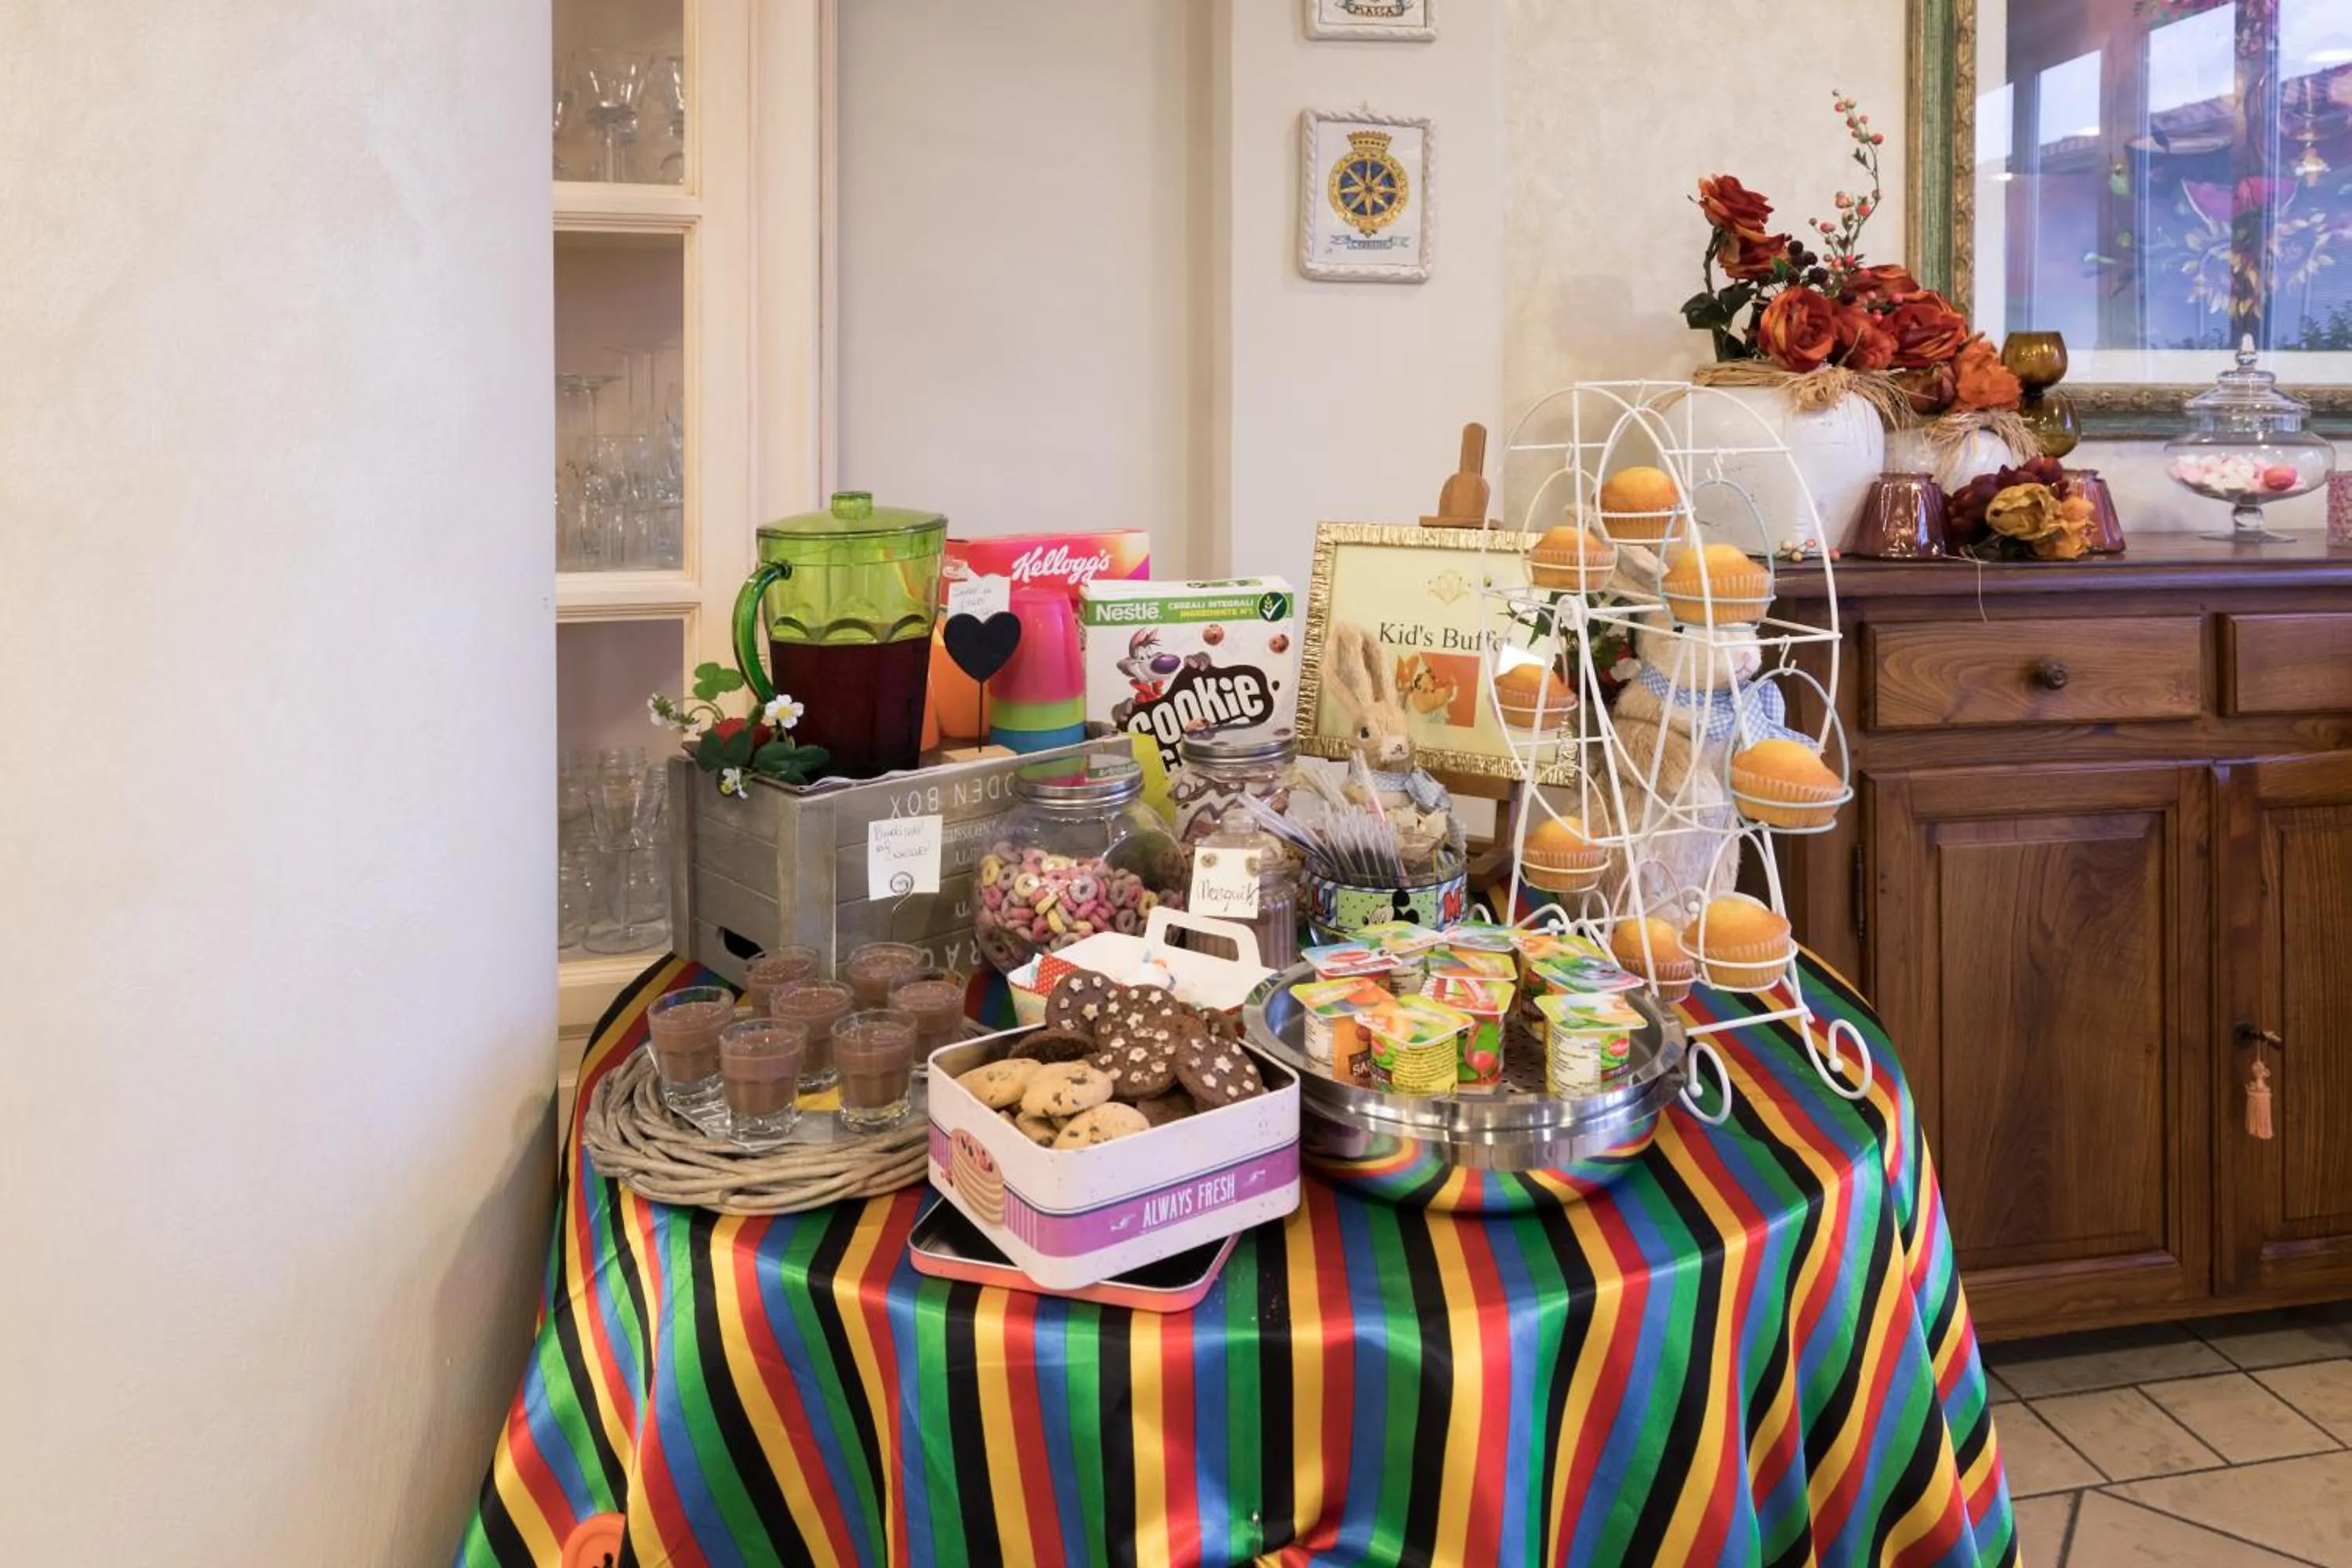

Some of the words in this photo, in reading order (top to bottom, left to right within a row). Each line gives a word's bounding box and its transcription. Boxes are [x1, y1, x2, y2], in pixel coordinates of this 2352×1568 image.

[1011, 544, 1113, 585] Kellogg's
[1096, 601, 1160, 622] Nestlé
[1167, 601, 1205, 610] CEREALI
[1207, 597, 1254, 608] INTEGRALI
[1379, 622, 1434, 648] Kid's
[891, 786, 940, 819] BOX
[1142, 1187, 1192, 1229] ALWAYS
[1197, 1172, 1236, 1210] FRESH
